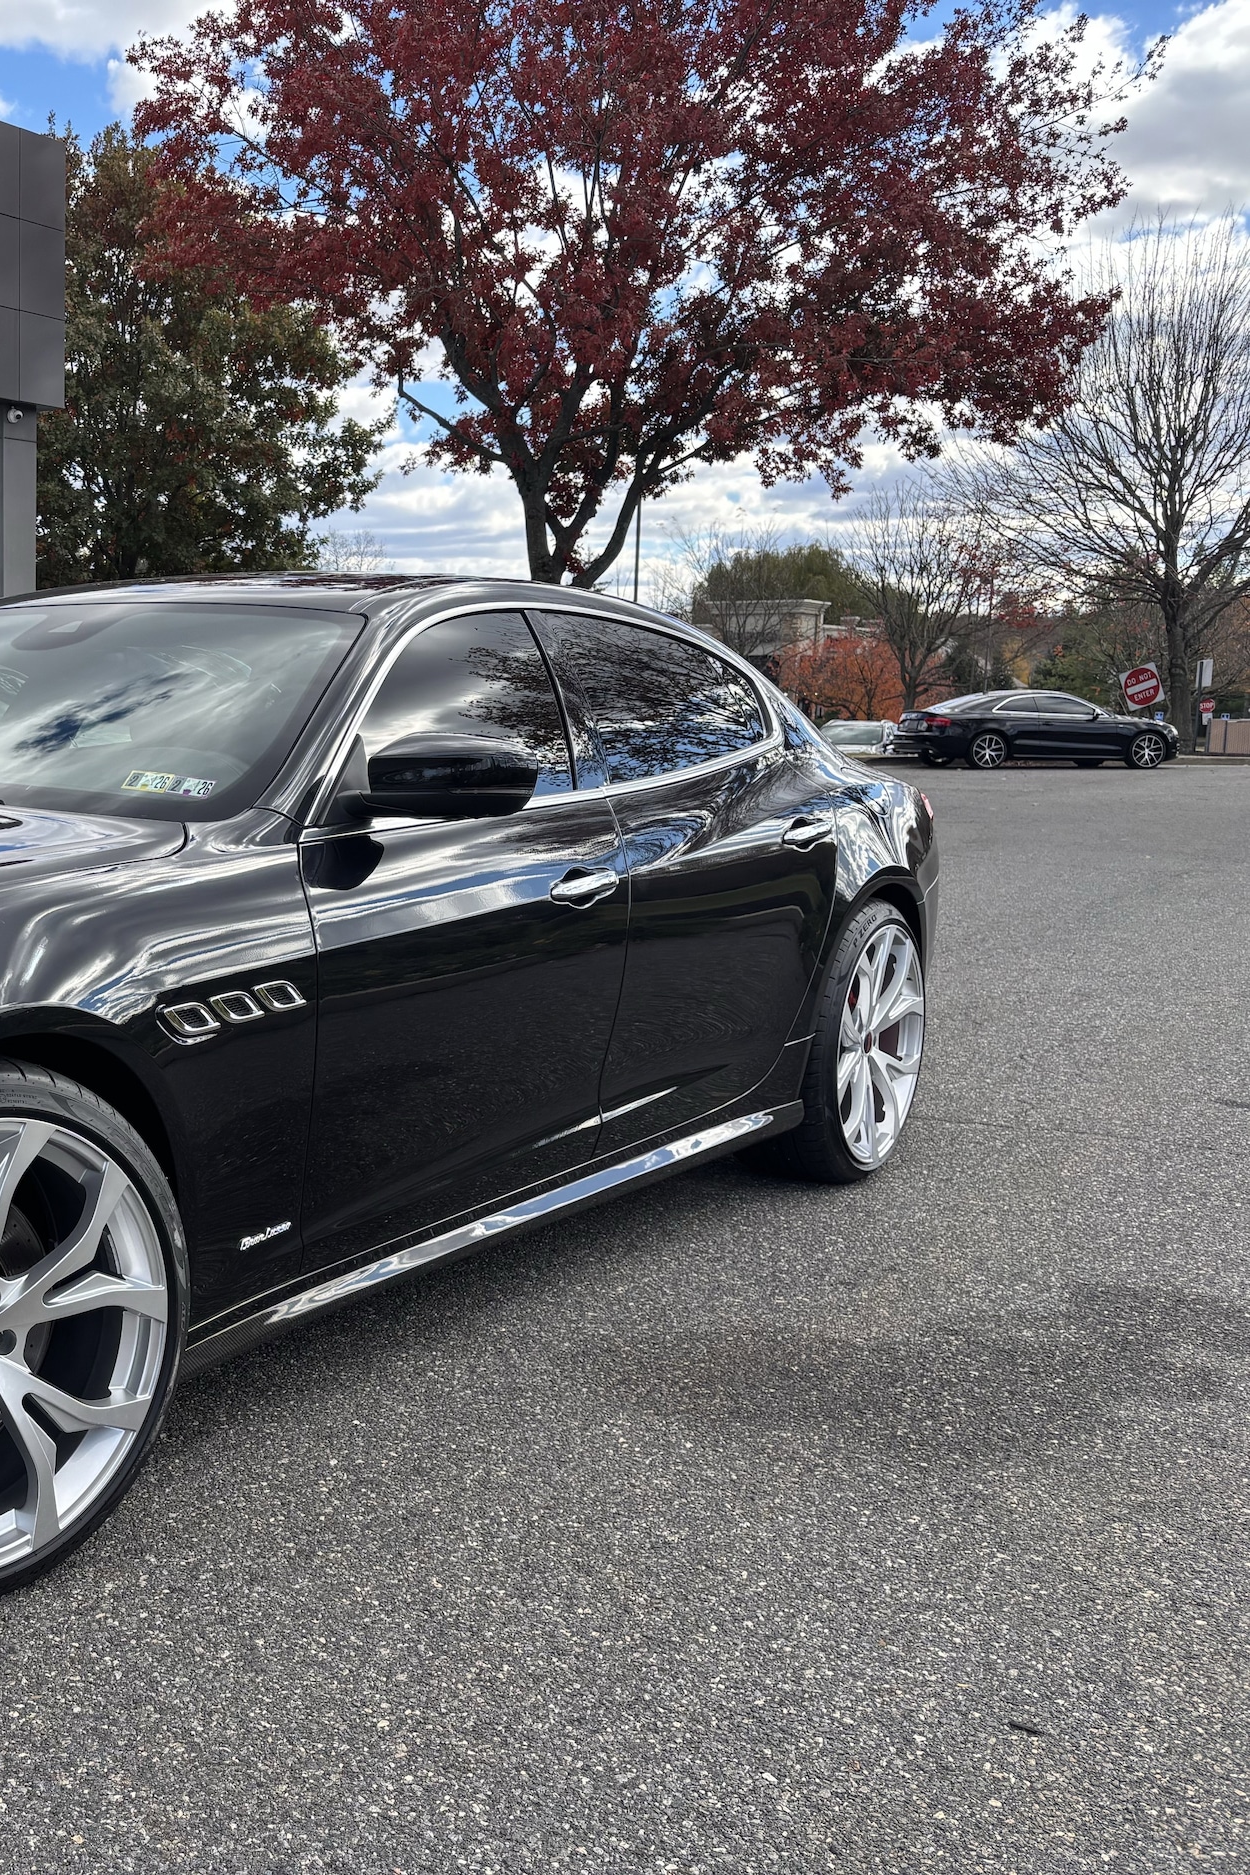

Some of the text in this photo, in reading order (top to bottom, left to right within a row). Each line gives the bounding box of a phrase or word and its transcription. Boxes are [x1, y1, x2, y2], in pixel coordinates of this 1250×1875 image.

[1126, 671, 1152, 686] DO NOT
[1133, 688, 1155, 702] ENTER
[154, 775, 170, 789] 26
[197, 781, 213, 795] 26
[858, 914, 877, 939] ZERO
